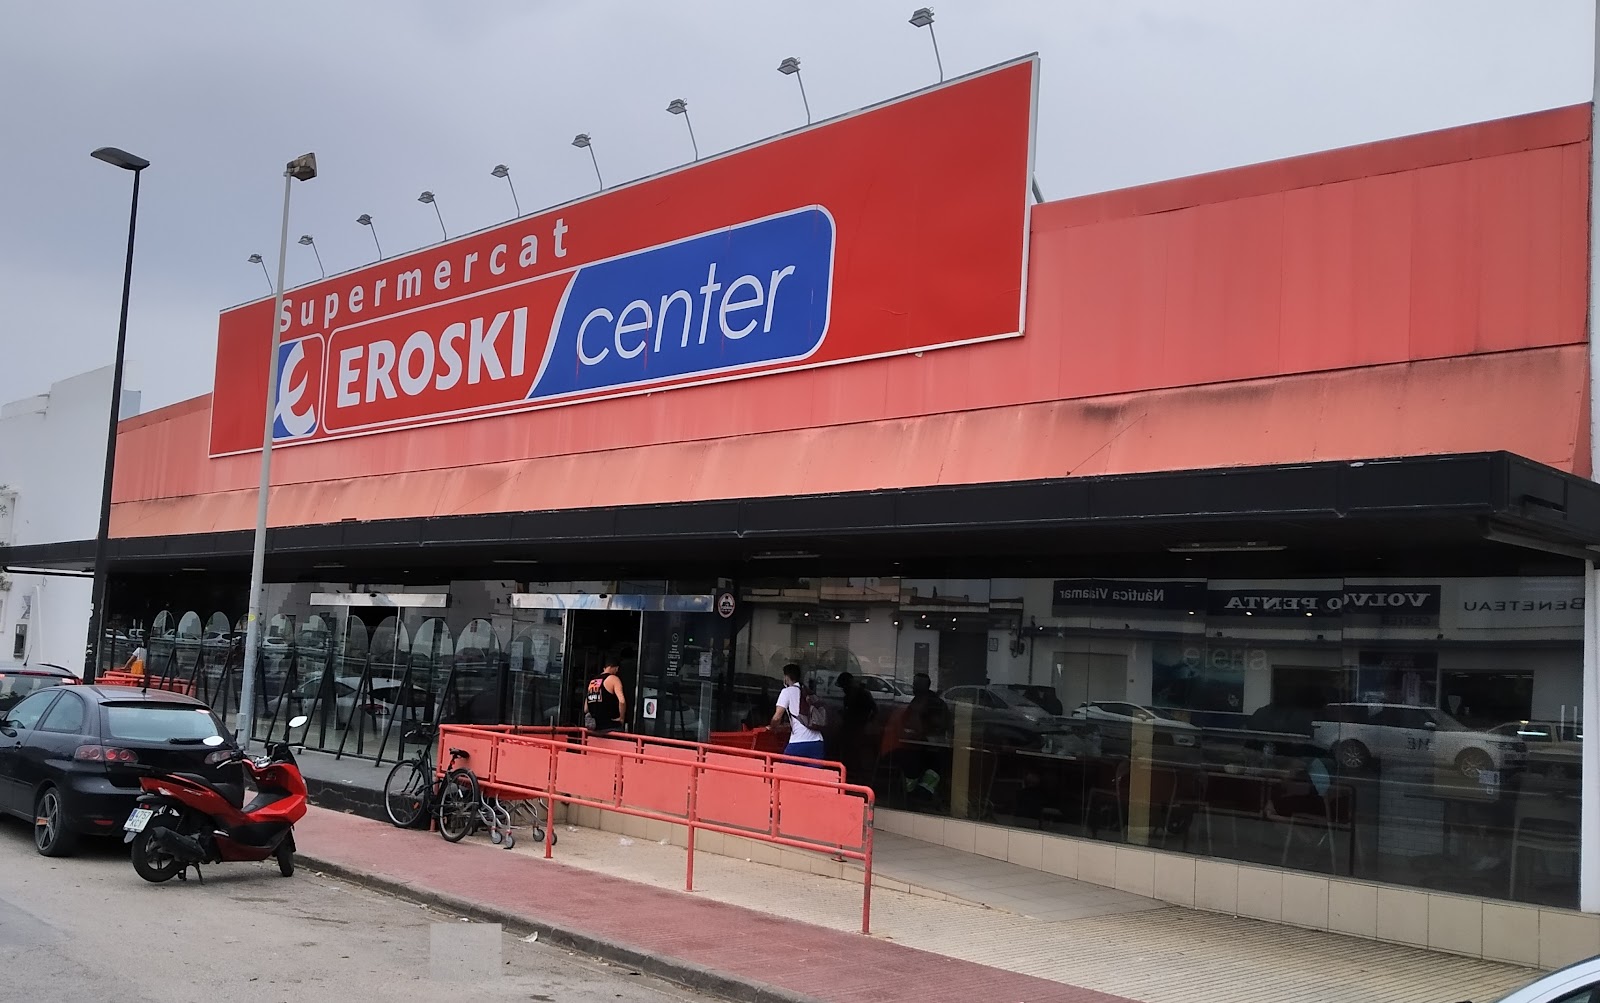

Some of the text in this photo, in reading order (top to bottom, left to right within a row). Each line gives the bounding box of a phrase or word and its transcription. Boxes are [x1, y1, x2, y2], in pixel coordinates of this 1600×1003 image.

[280, 218, 569, 333] Supermercat
[337, 261, 796, 408] EROSKI center
